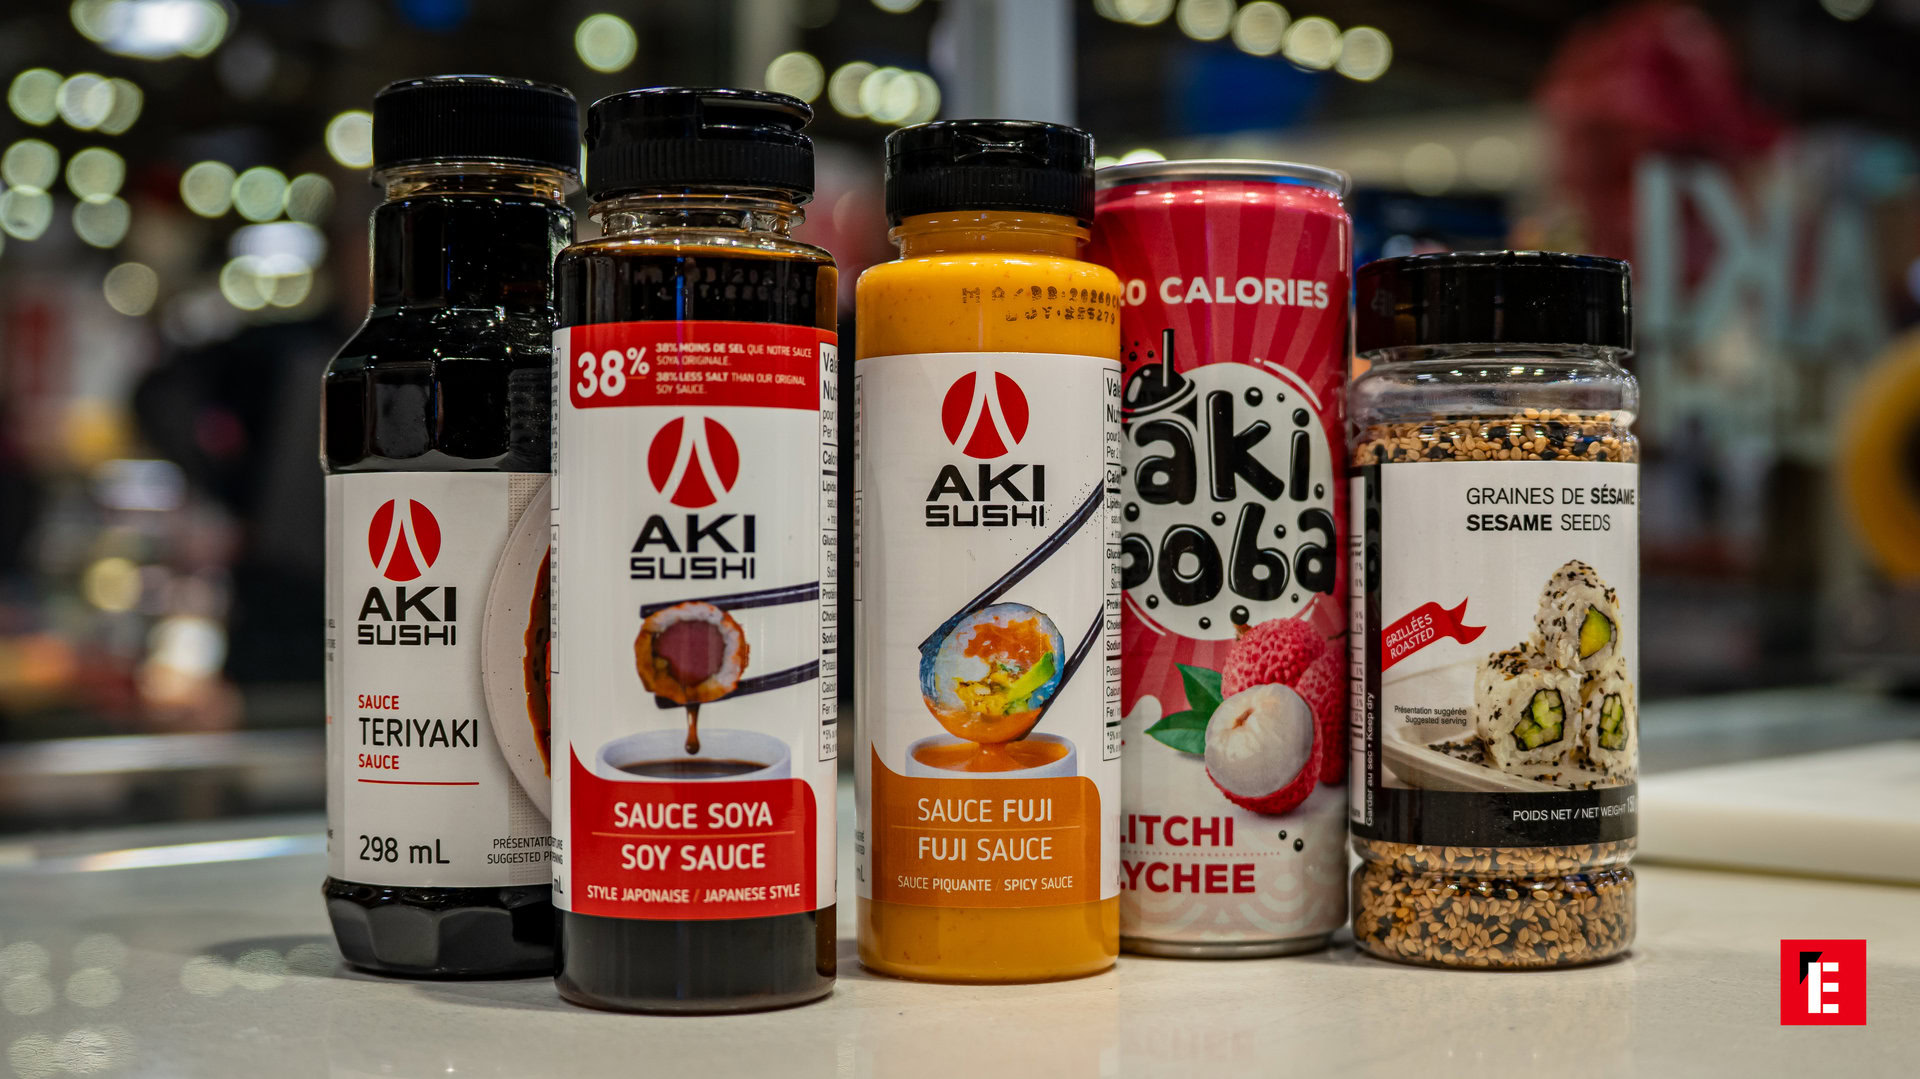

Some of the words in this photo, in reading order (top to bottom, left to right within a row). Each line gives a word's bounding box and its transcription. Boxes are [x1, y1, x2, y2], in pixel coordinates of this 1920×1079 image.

[1120, 277, 1147, 306] 0
[1159, 276, 1330, 309] CALORIES
[655, 343, 678, 353] 38%
[679, 342, 711, 353] MOINS
[713, 343, 726, 353] DE
[728, 343, 745, 354] SEL
[747, 344, 764, 355] QUE
[766, 345, 790, 356] NOTRE
[792, 347, 812, 358] SAUCE
[656, 355, 679, 366] SOYA
[576, 347, 650, 398] 38%
[655, 372, 678, 382] 38%
[679, 372, 702, 382] LESS
[705, 372, 728, 382] SALT
[731, 373, 754, 383] THAN
[756, 373, 772, 383] OUR
[774, 374, 806, 386] ORIGINAL
[656, 384, 673, 394] SOY
[1134, 390, 1311, 506] aki
[926, 463, 1046, 502] AKI
[1466, 487, 1554, 505] GRAINES
[1562, 488, 1584, 504] DE
[1590, 484, 1635, 505] SÉSAME
[925, 504, 1045, 527] SUSHI
[1466, 513, 1552, 532] SESAME
[1560, 513, 1611, 532] SEEDS
[631, 514, 756, 553] AKI
[630, 557, 755, 580] SUSHI
[358, 586, 457, 622] AKI
[357, 624, 457, 646] SUSHI
[1385, 613, 1433, 648] GRILLÉES
[1390, 627, 1435, 659] ROASTED
[358, 695, 400, 710] SAUCE
[1366, 692, 1375, 710] dry
[1394, 705, 1432, 715] Présentation
[1434, 707, 1467, 716] suggérée
[1366, 712, 1374, 741] Keep
[1405, 715, 1440, 725] Suggested
[1441, 717, 1467, 726] serving
[358, 717, 479, 748] TERIYAKI
[358, 754, 400, 770] SAUCE
[1367, 773, 1373, 787] au
[613, 801, 699, 830] SAUCE
[707, 801, 773, 830] SOYA
[917, 797, 993, 823] SAUCE
[1003, 798, 1052, 823] FUJI
[1512, 809, 1549, 821] POIDS
[1550, 808, 1572, 820] NET
[1581, 806, 1599, 819] NET
[1600, 803, 1626, 817] WEIGHT
[1120, 814, 1234, 847] ITCHI
[359, 835, 399, 863] 298
[409, 839, 450, 865] mL
[487, 852, 541, 865] SUGGESTED
[620, 843, 671, 871] SOY
[680, 843, 766, 871] SAUCE
[918, 837, 967, 862] FUJI
[976, 836, 1053, 862] SAUCE
[897, 875, 929, 890] SAUCE
[932, 876, 992, 892] PIQUANTE
[1003, 877, 1038, 891] SPICY
[1041, 875, 1073, 889] SAUCE
[1120, 860, 1256, 894] YCHEE
[587, 885, 618, 901] STYLE
[621, 887, 690, 904] JAPONAISE
[702, 886, 766, 904] JAPANESE
[768, 883, 801, 899] STYLE
